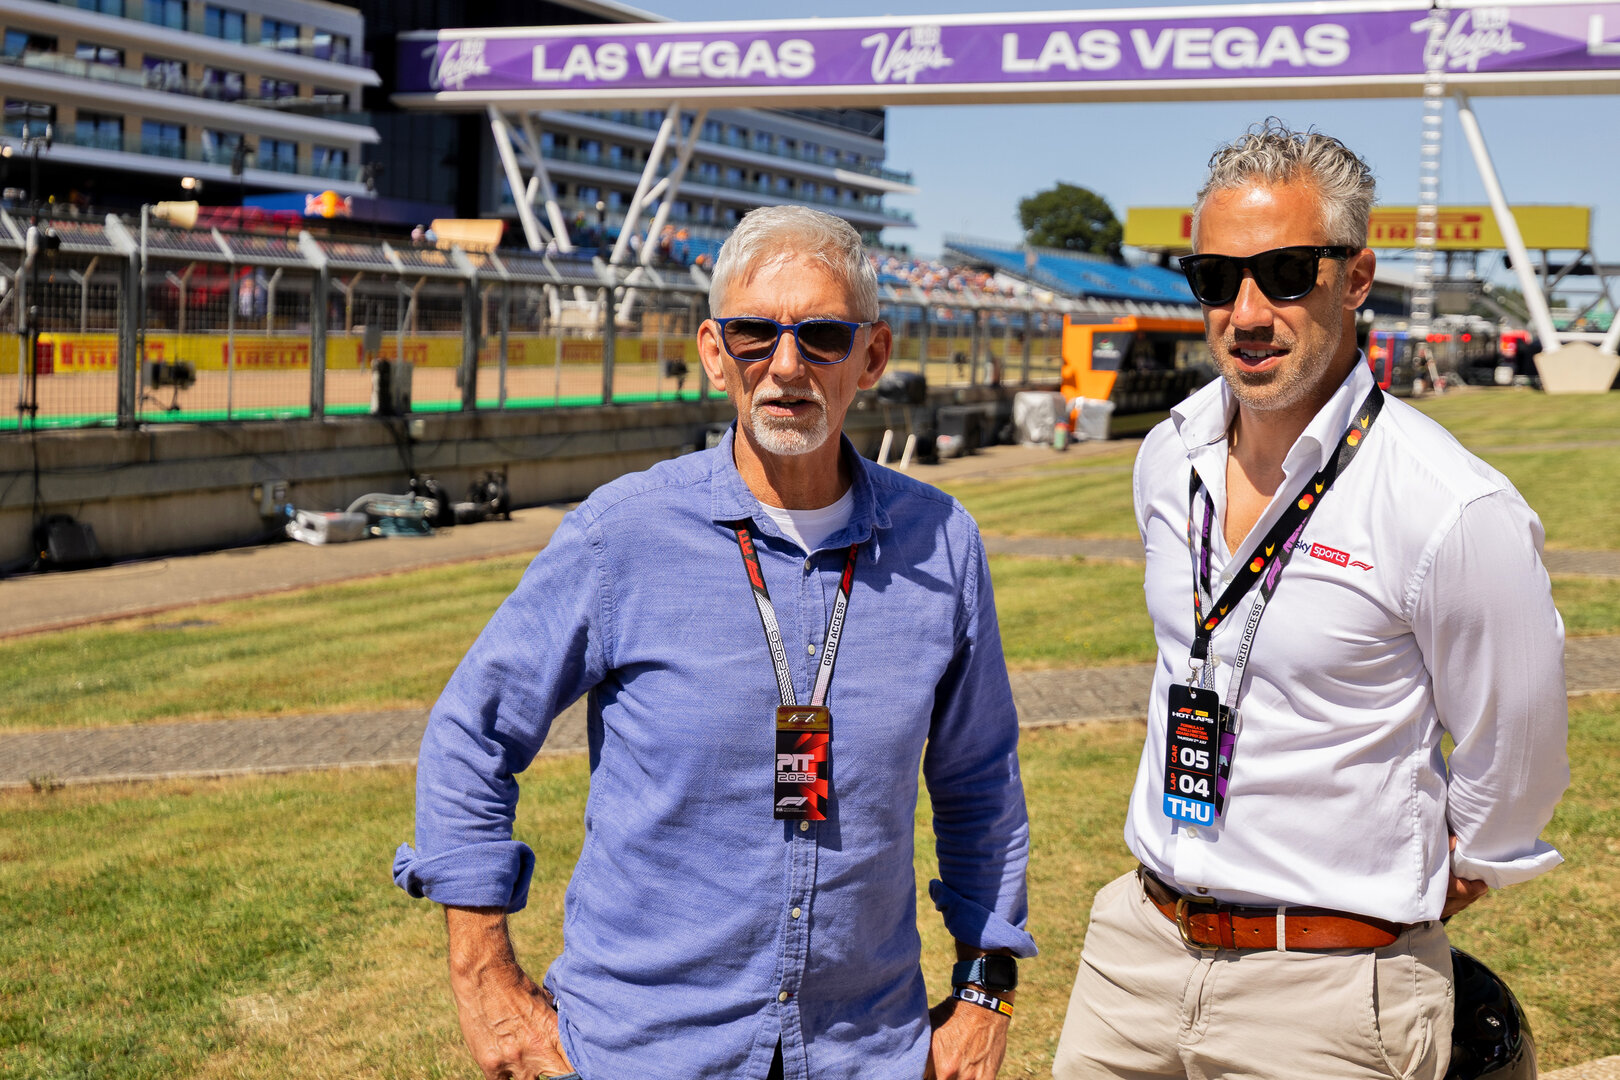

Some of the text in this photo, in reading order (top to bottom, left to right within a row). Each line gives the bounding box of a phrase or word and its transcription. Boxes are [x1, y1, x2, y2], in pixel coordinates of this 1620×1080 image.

[1001, 23, 1351, 73] LAS VEGAS
[531, 43, 629, 82] LAS
[634, 40, 816, 80] VEGAS
[1295, 540, 1311, 554] sky
[1313, 546, 1347, 563] sports
[823, 602, 845, 667] GRID ACCESS
[1236, 603, 1263, 669] GRID ACCESS
[1172, 711, 1190, 719] HOT
[1190, 715, 1214, 724] LAPS
[776, 753, 815, 772] PIT
[1180, 747, 1209, 769] 05
[777, 772, 817, 783] 2026
[1178, 774, 1210, 798] 04
[1167, 796, 1210, 822] THU
